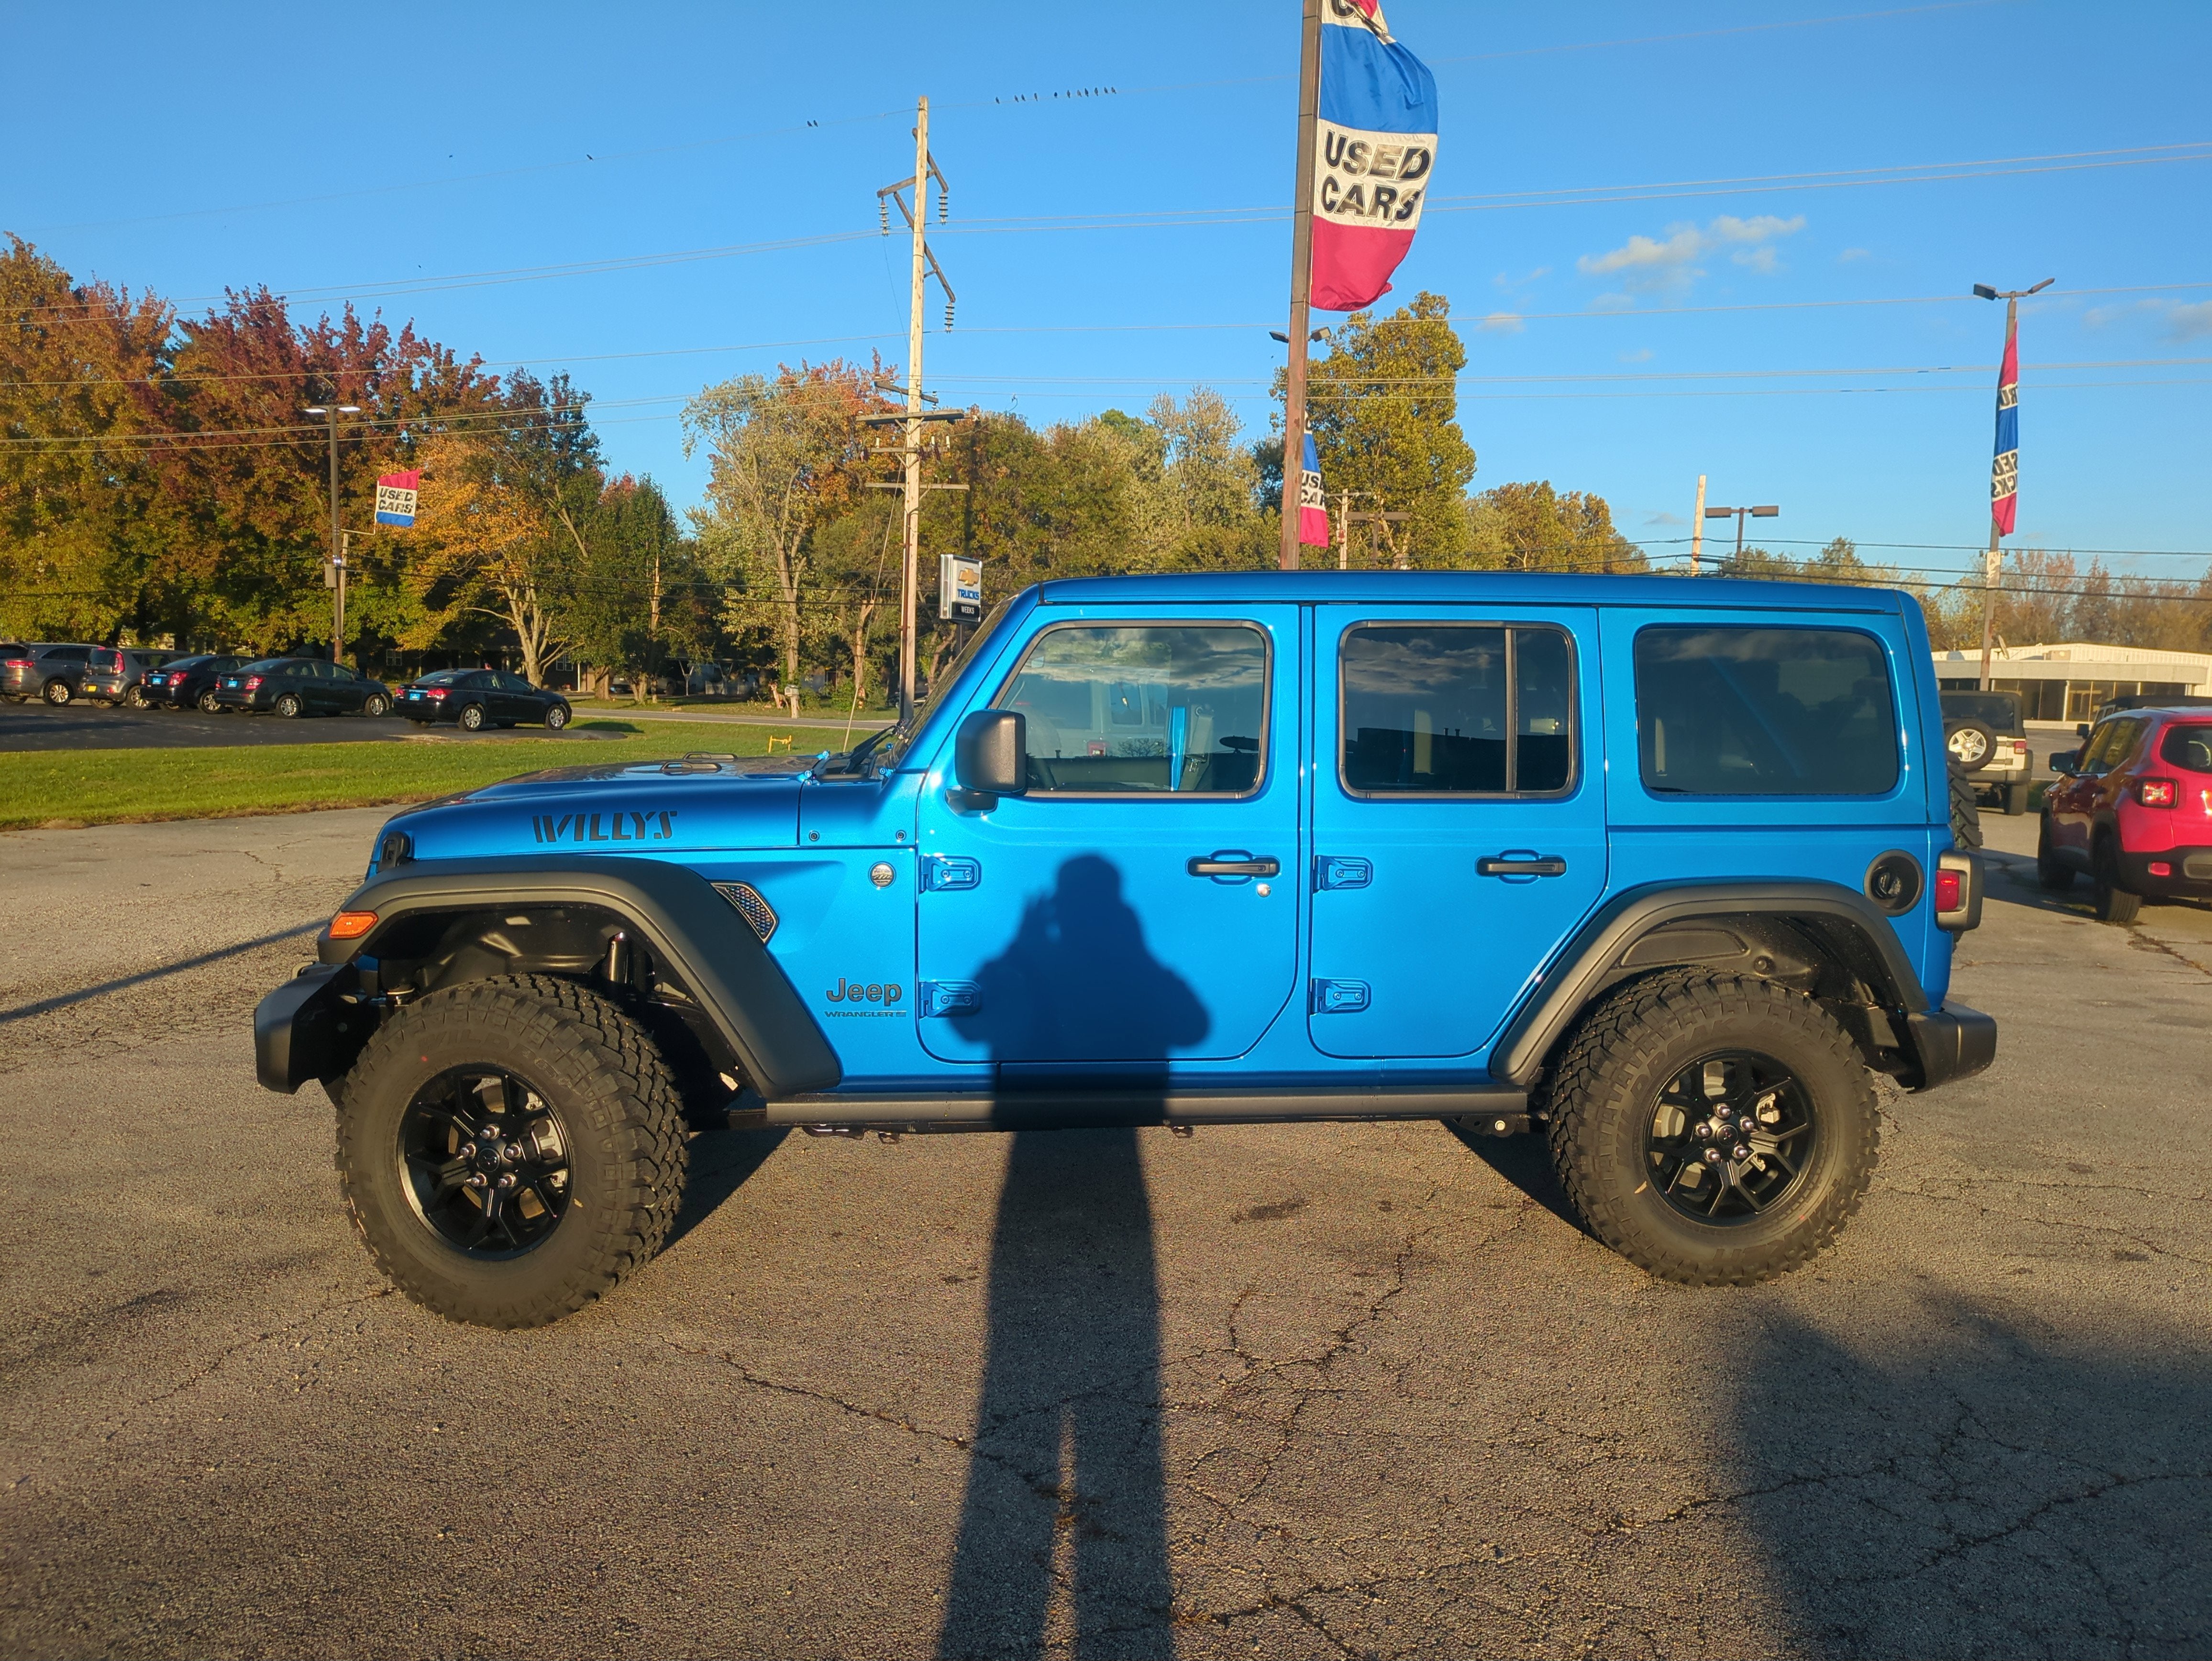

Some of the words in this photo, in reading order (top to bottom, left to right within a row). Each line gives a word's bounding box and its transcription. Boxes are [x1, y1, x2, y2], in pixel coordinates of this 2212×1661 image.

[1324, 130, 1431, 181] USED
[1321, 174, 1422, 221] CARS
[1302, 472, 1323, 490] US
[379, 487, 414, 502] USED
[1301, 489, 1325, 506] CA
[378, 499, 413, 514] CARS
[958, 588, 979, 600] TRUCKS
[961, 605, 975, 614] WEEKS
[532, 811, 678, 843] WILLYS
[826, 978, 902, 1007] Jeep
[417, 1029, 589, 1129] WILDPEAK
[1616, 1019, 1738, 1168] WILDPEAK
